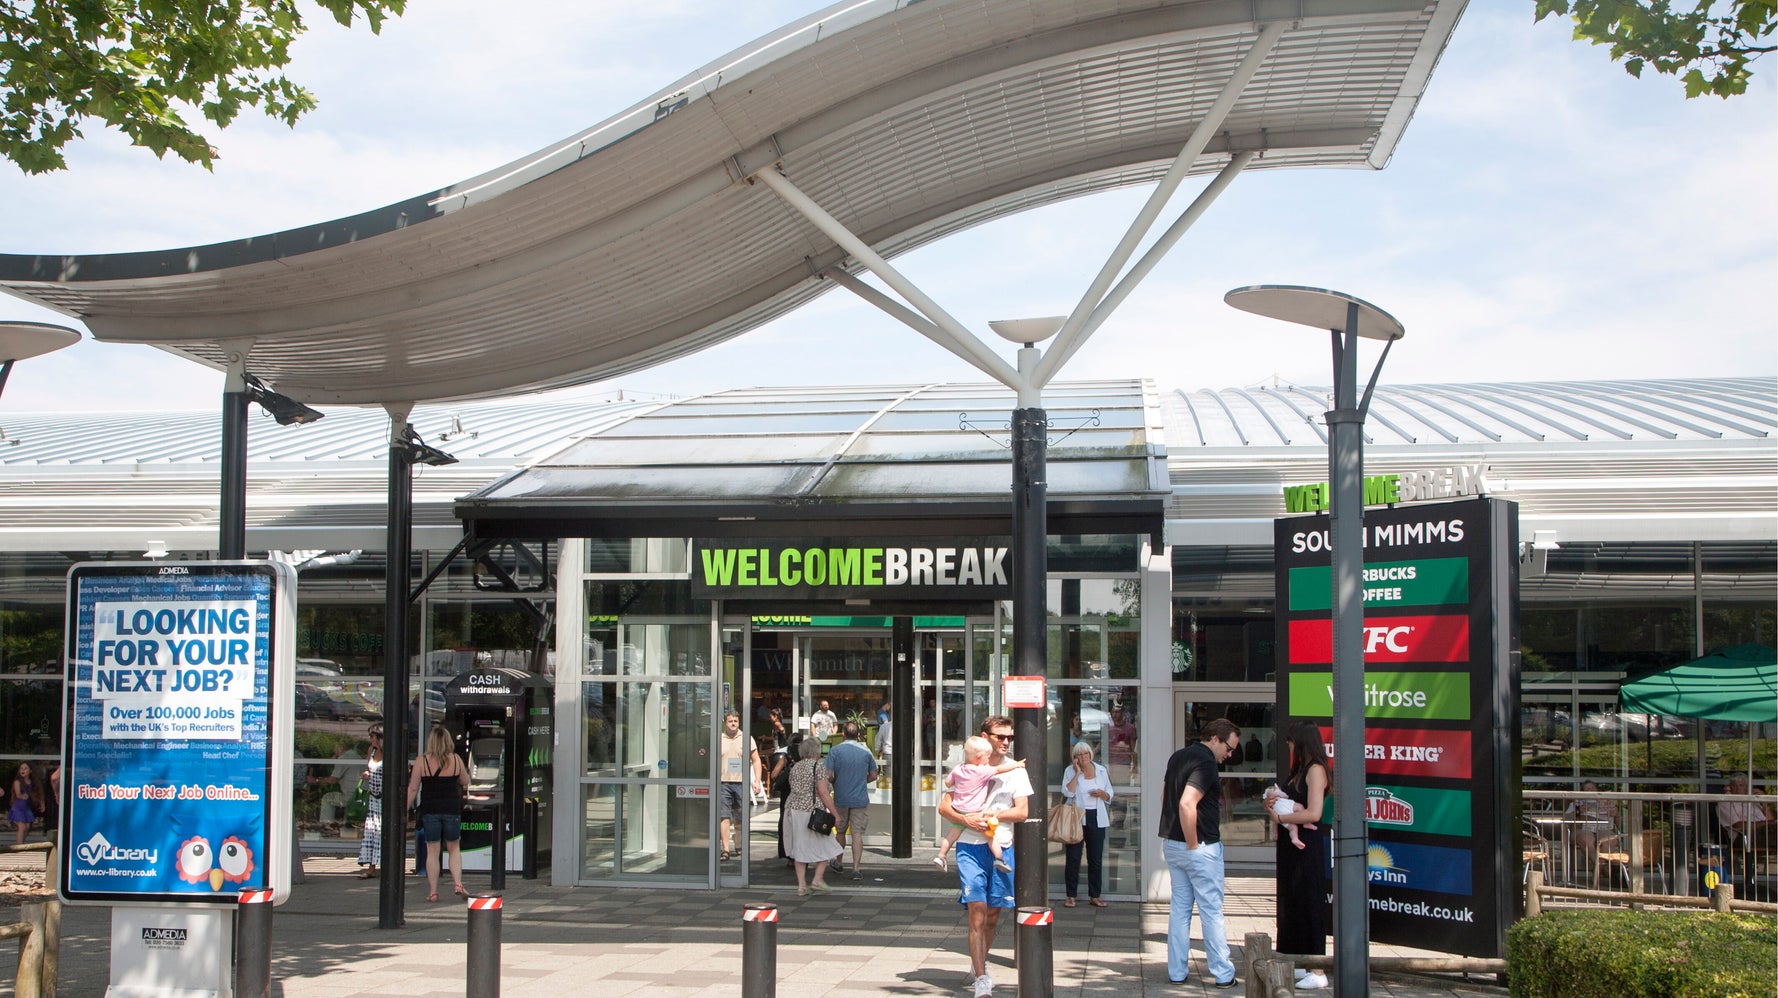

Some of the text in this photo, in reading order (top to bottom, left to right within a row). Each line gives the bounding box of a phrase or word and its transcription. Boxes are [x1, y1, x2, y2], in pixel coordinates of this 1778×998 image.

[1283, 465, 1491, 513] WELMEBREAK
[1292, 519, 1464, 553] SOU MIMMS
[159, 567, 189, 575] ADMEDIA
[701, 547, 1008, 586] WELCOMEBREAK
[94, 586, 129, 595] Developer
[181, 584, 213, 592] Financial
[215, 584, 242, 592] Advisor
[98, 639, 249, 666] FOR YOUR
[96, 669, 167, 692] NEXT
[469, 675, 501, 685] CASH
[460, 685, 511, 694] withdrawals
[110, 706, 235, 721] Over 100,000 Jobs
[110, 722, 129, 732] with
[131, 722, 147, 732] the
[171, 723, 188, 733] Top
[189, 722, 235, 732] Recruiters
[156, 742, 189, 751] Engineer
[203, 751, 220, 759] Head
[221, 751, 240, 759] Chef
[1390, 745, 1439, 762] KING
[79, 784, 259, 801] Find Your Next Job Online...
[1368, 788, 1386, 796] PIZZA
[76, 868, 157, 878] www.cv-library.co.uk
[1384, 869, 1407, 884] Inn
[143, 929, 186, 939] ADMEDIA
